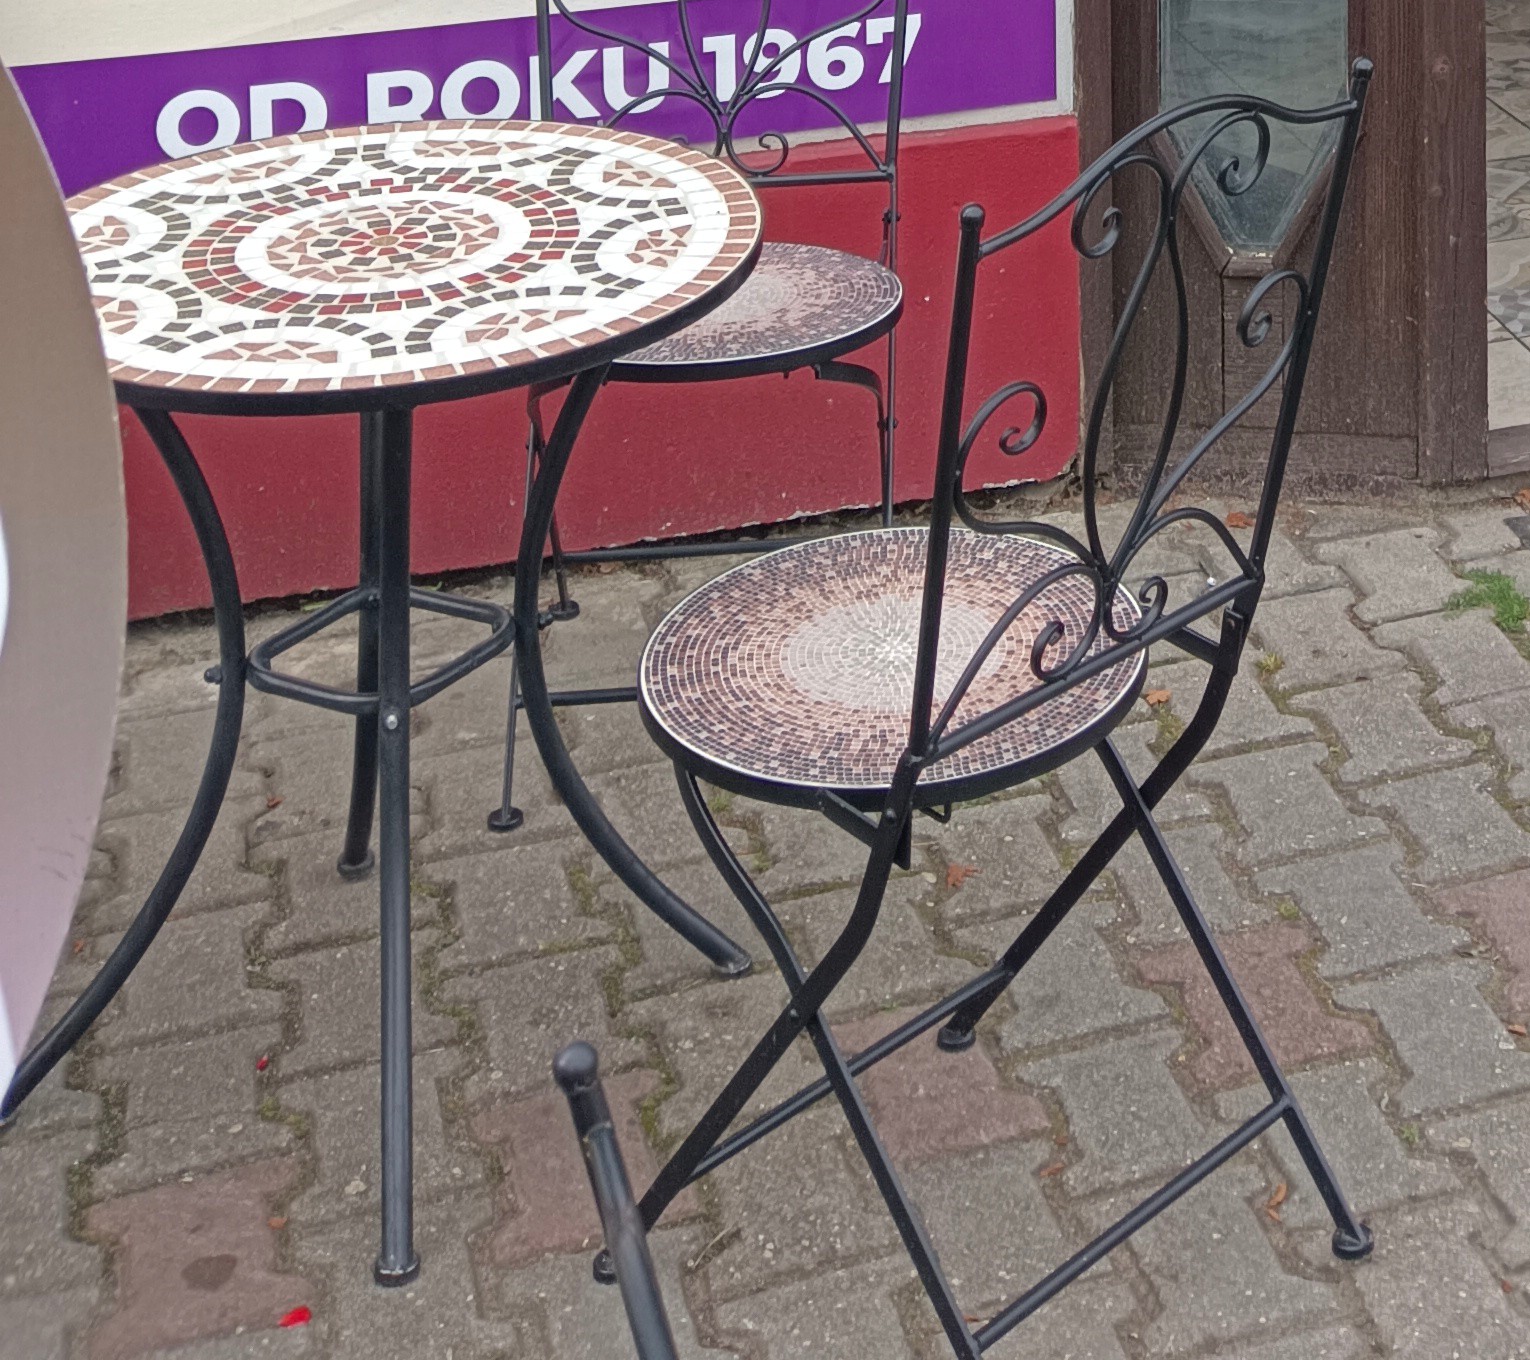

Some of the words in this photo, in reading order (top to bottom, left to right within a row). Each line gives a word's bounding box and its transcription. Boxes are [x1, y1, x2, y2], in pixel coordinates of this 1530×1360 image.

[155, 82, 327, 158] OD
[367, 42, 671, 122] ROKU
[702, 14, 923, 102] 1967
